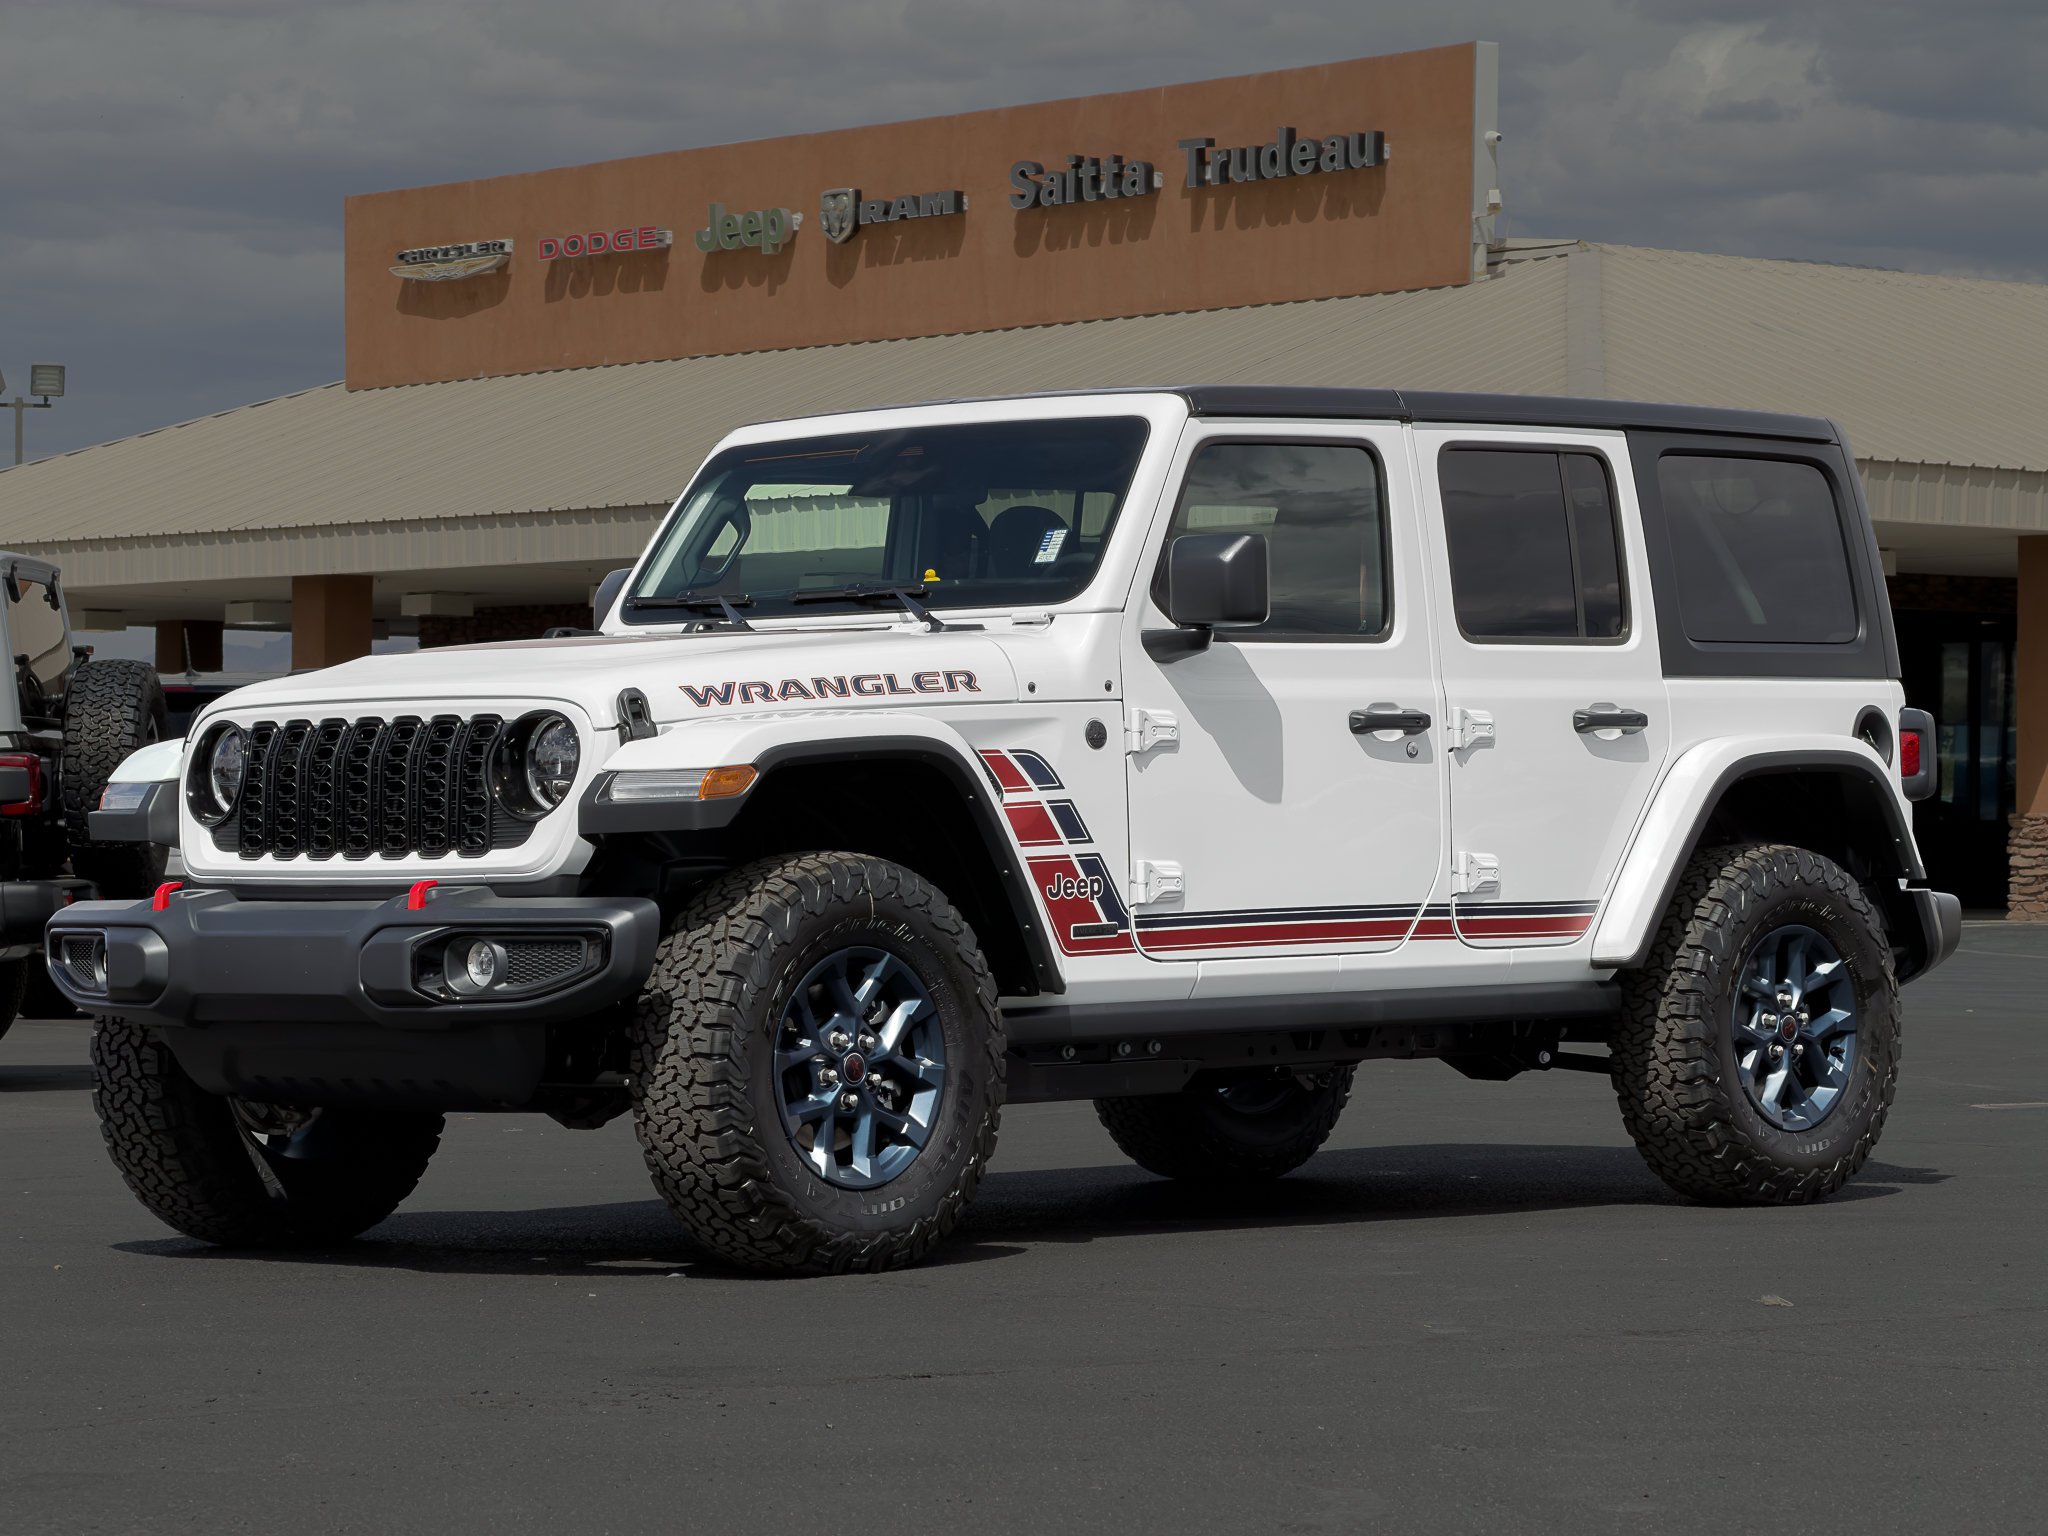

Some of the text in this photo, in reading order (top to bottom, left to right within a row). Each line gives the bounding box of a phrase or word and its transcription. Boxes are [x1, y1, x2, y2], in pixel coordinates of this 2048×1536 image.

[1009, 126, 1385, 209] Saitta Trudeau
[859, 190, 960, 225] RAM
[538, 226, 664, 261] DODGE
[694, 203, 786, 254] Jeep
[395, 240, 508, 263] CHRYSLER
[679, 670, 981, 708] WRANGLER
[1046, 872, 1104, 903] Jeep
